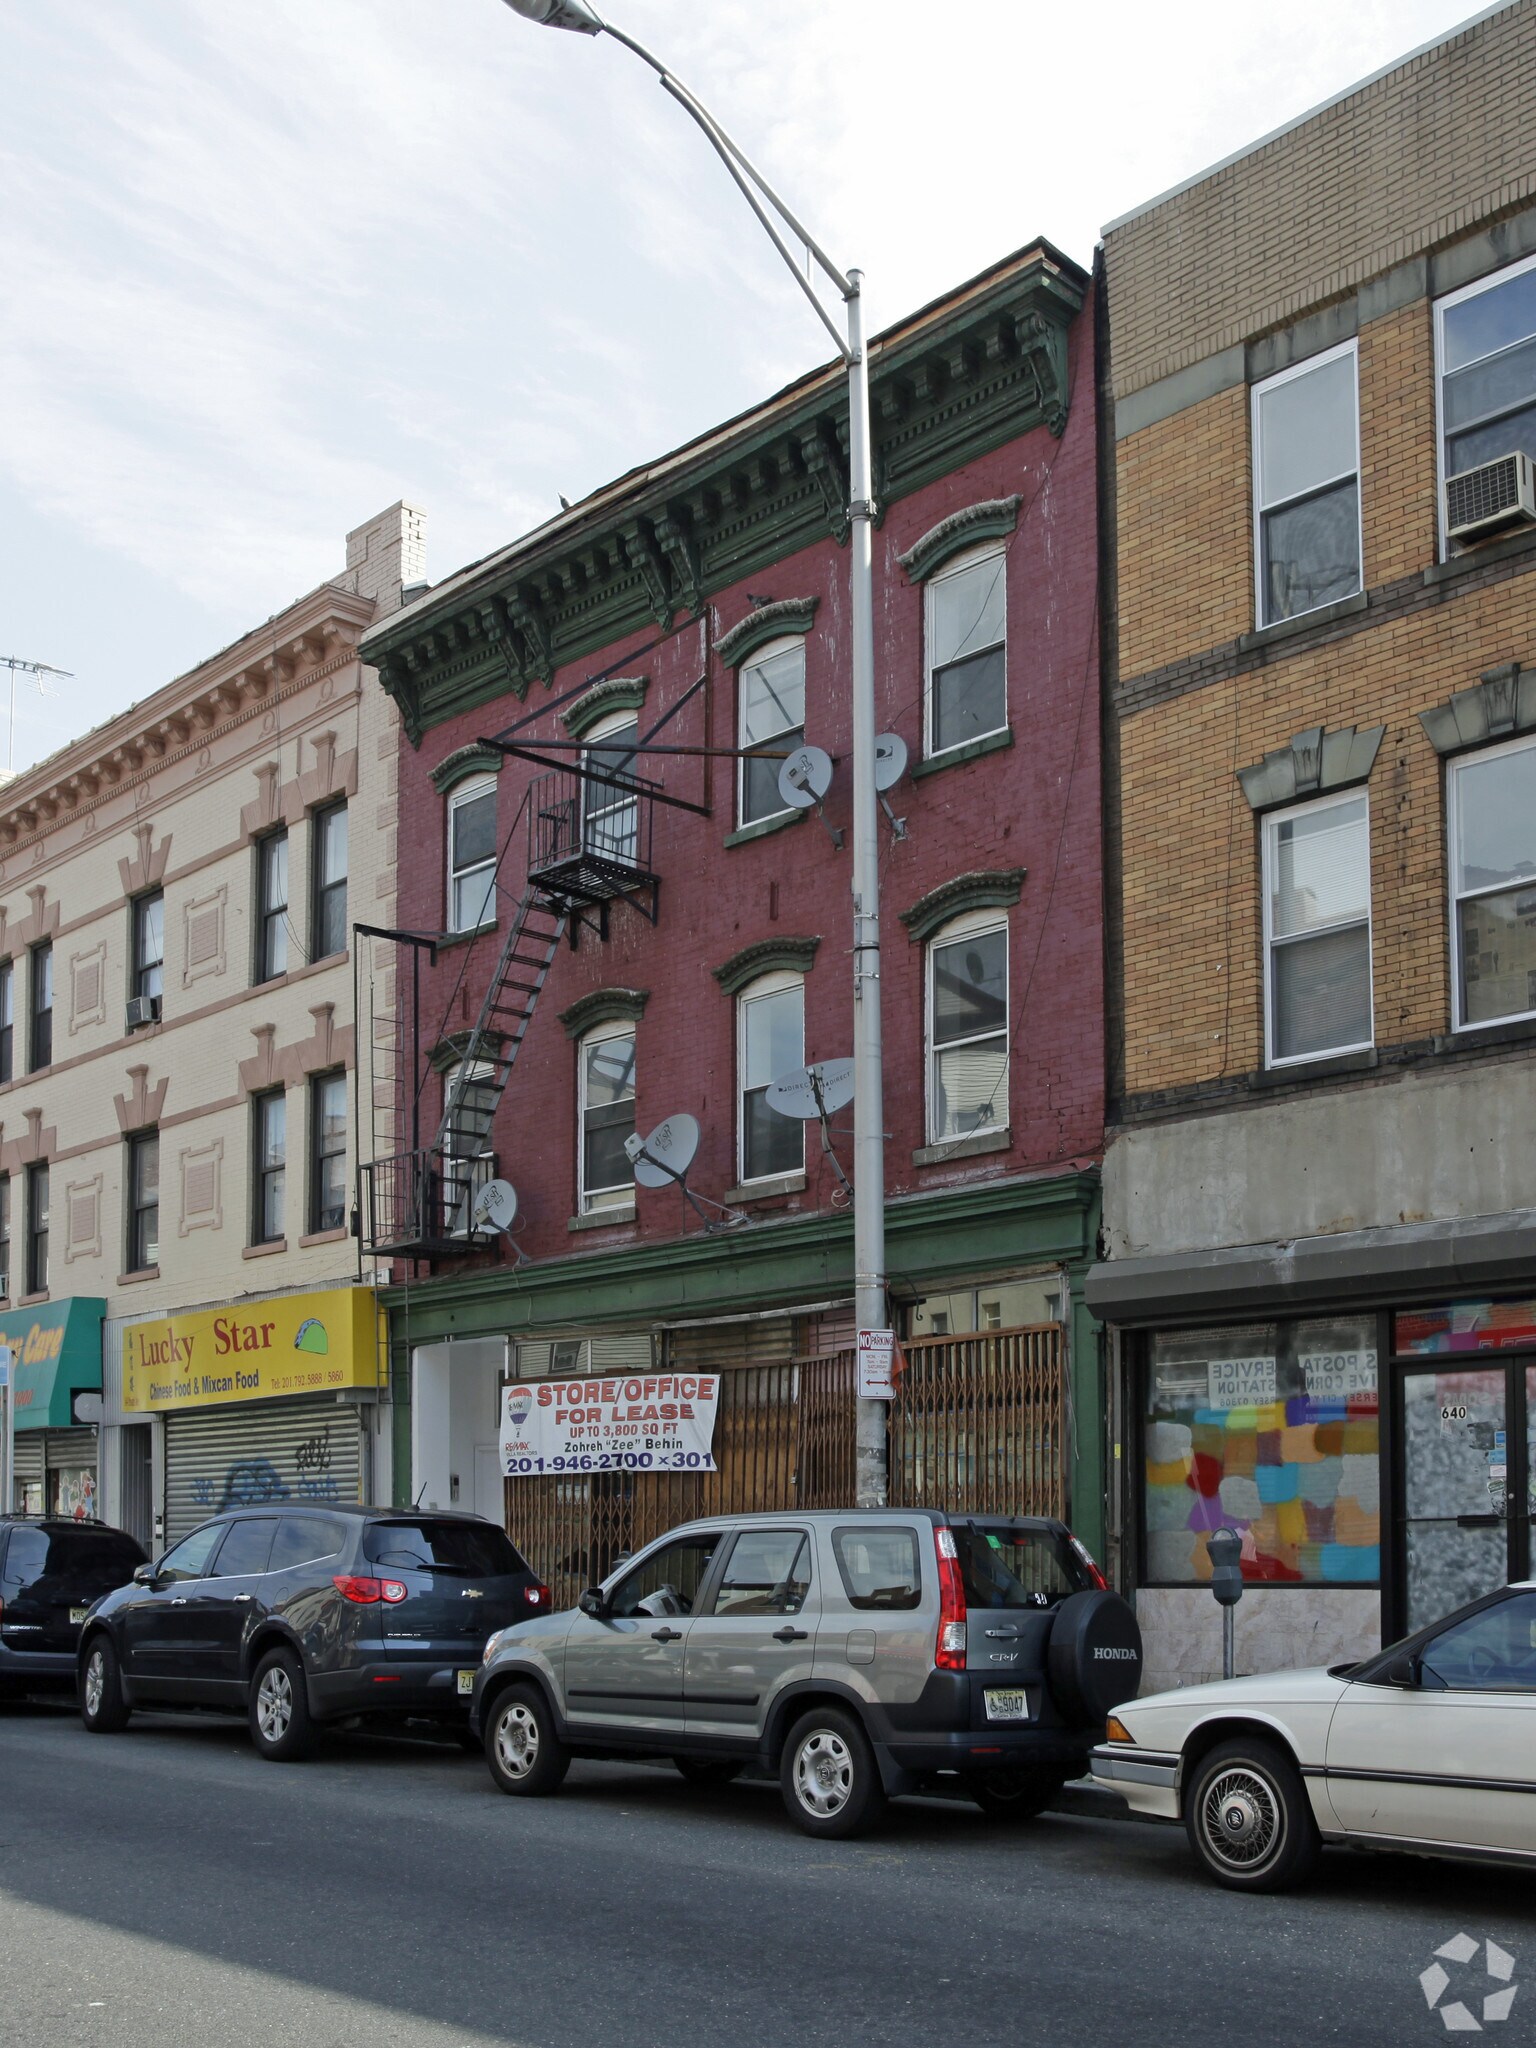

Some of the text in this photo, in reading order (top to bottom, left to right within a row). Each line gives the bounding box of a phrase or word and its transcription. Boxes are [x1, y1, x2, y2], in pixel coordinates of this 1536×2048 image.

[829, 1071, 851, 1086] DIRECT
[23, 1322, 64, 1367] Care
[139, 1327, 195, 1374] Lucky
[213, 1318, 276, 1355] Star
[860, 1334, 894, 1348] NO PARKING
[149, 1368, 260, 1401] Chinese Food & Mixcan Food
[536, 1377, 715, 1407] STORE/OFFICE
[555, 1403, 695, 1425] FOR LEASE
[1441, 1406, 1467, 1419] 640
[569, 1422, 678, 1439] UP TO 3,800 SQ FT
[564, 1438, 603, 1452] Zohreh
[645, 1438, 683, 1449] Behin
[506, 1452, 653, 1473] 201-946-2700
[671, 1452, 713, 1468] 301
[1093, 1647, 1138, 1660] HONDA
